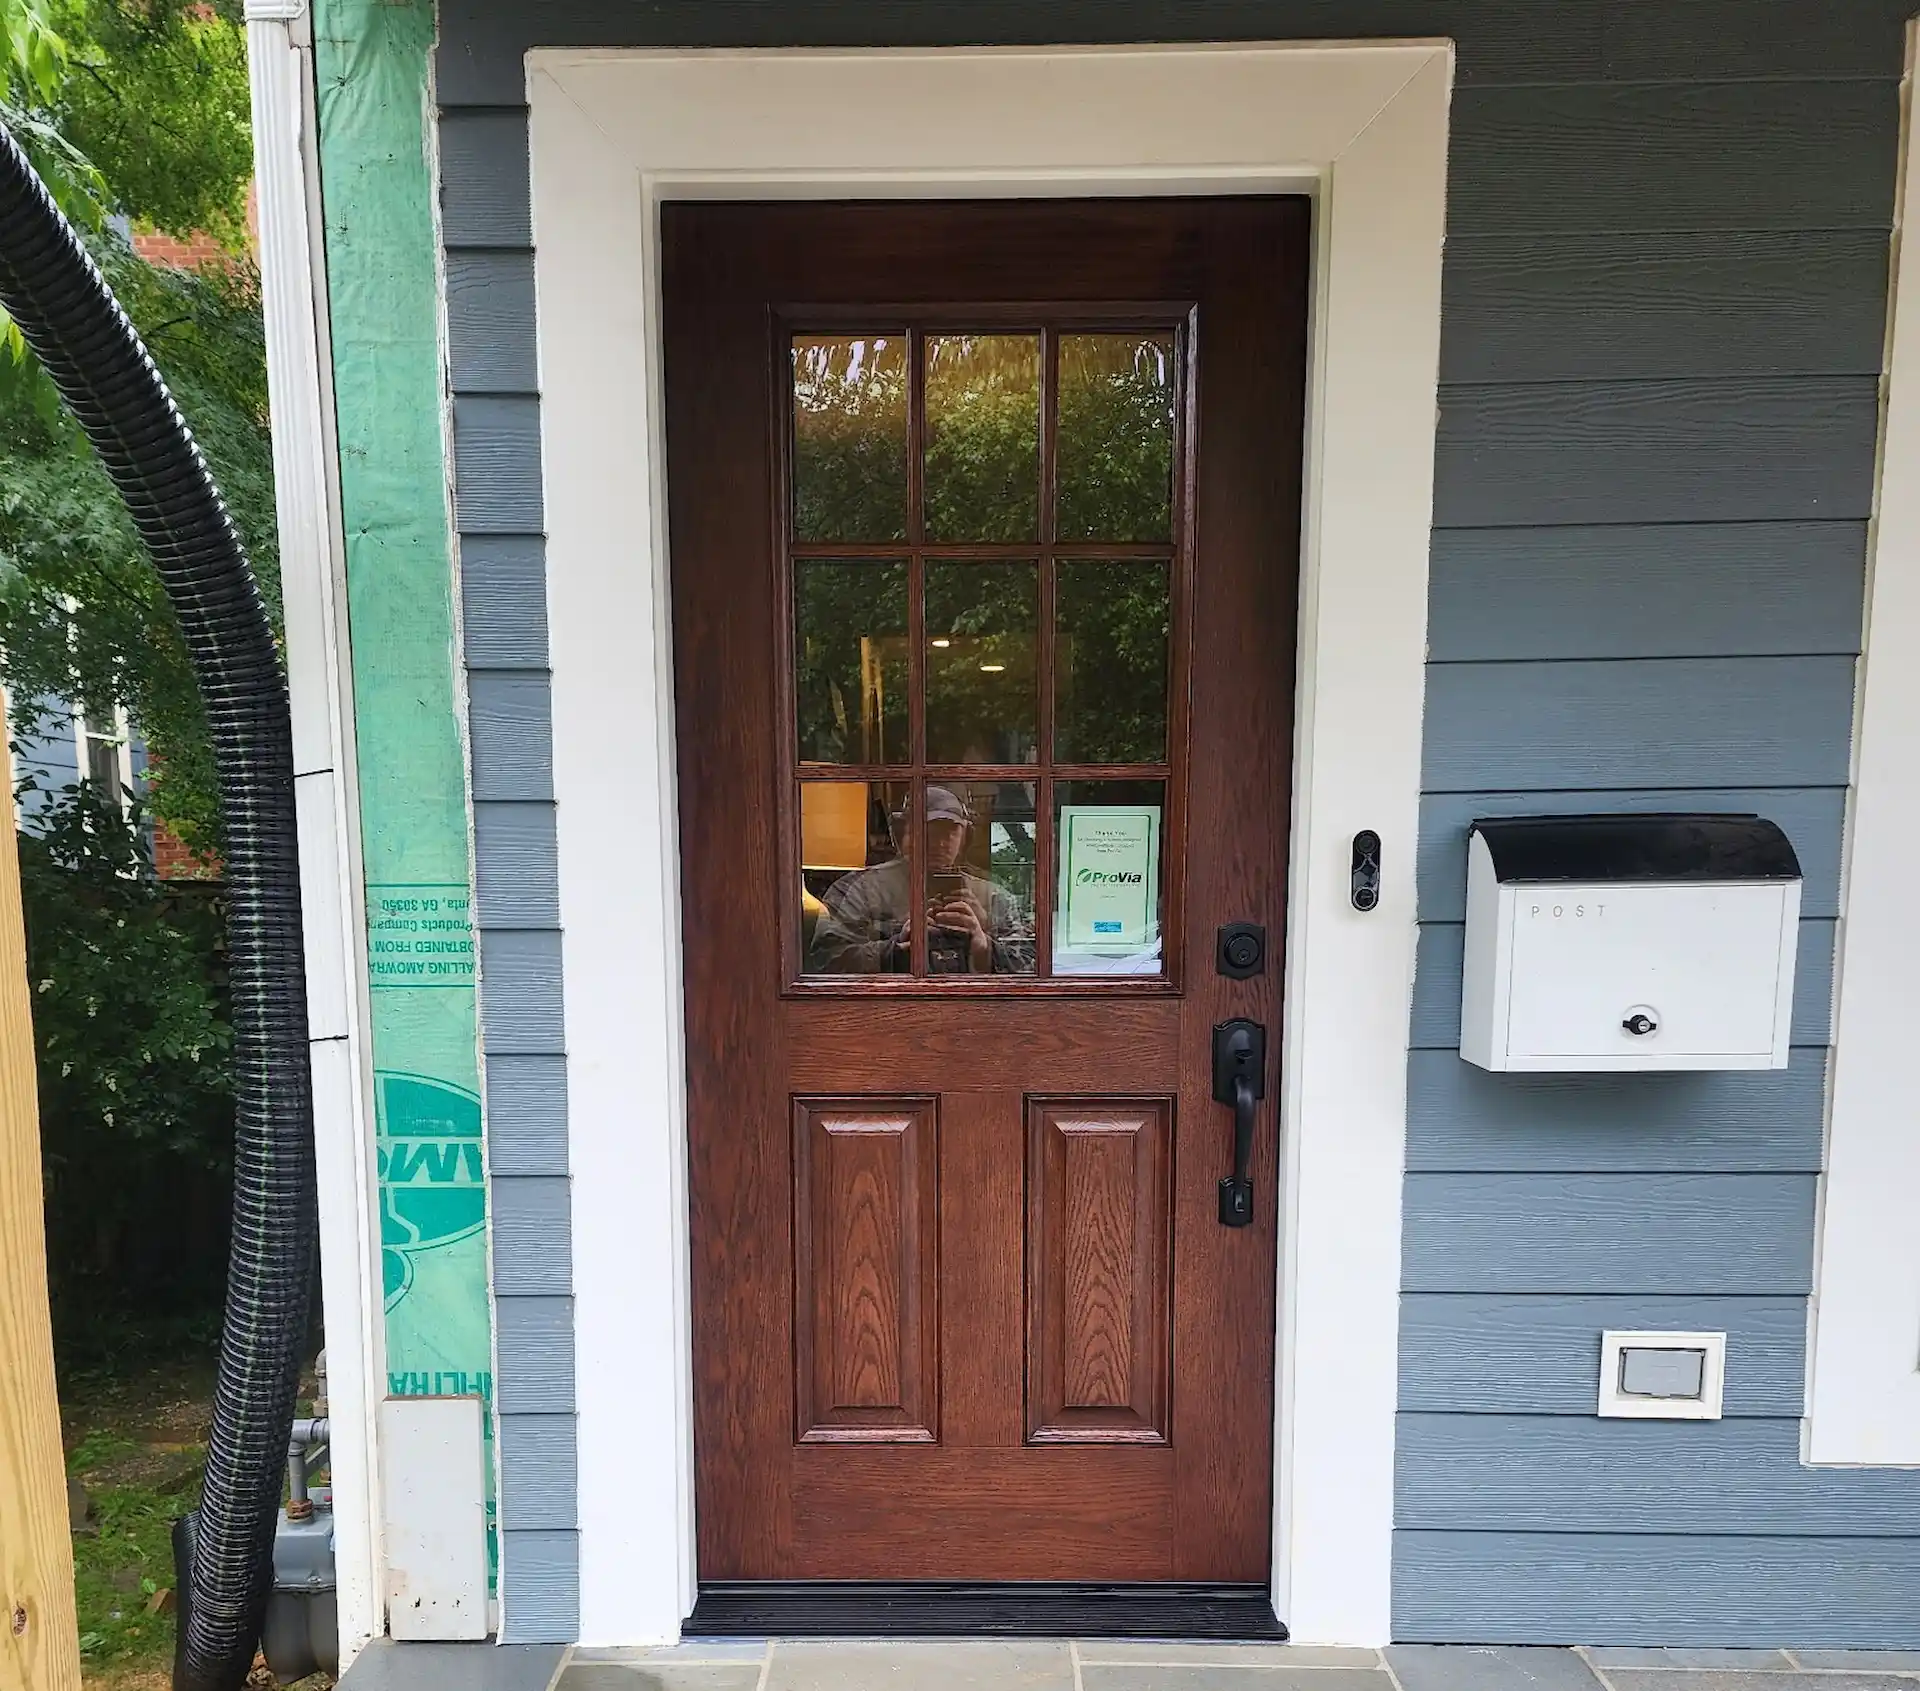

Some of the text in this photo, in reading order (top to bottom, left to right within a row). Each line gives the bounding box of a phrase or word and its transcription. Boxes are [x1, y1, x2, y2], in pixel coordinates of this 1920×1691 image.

[1092, 872, 1142, 883] ProVia
[421, 899, 438, 911] GA
[1531, 905, 1606, 918] POST
[421, 920, 473, 932] Products
[375, 940, 411, 953] FROM
[428, 962, 474, 974] ALLING
